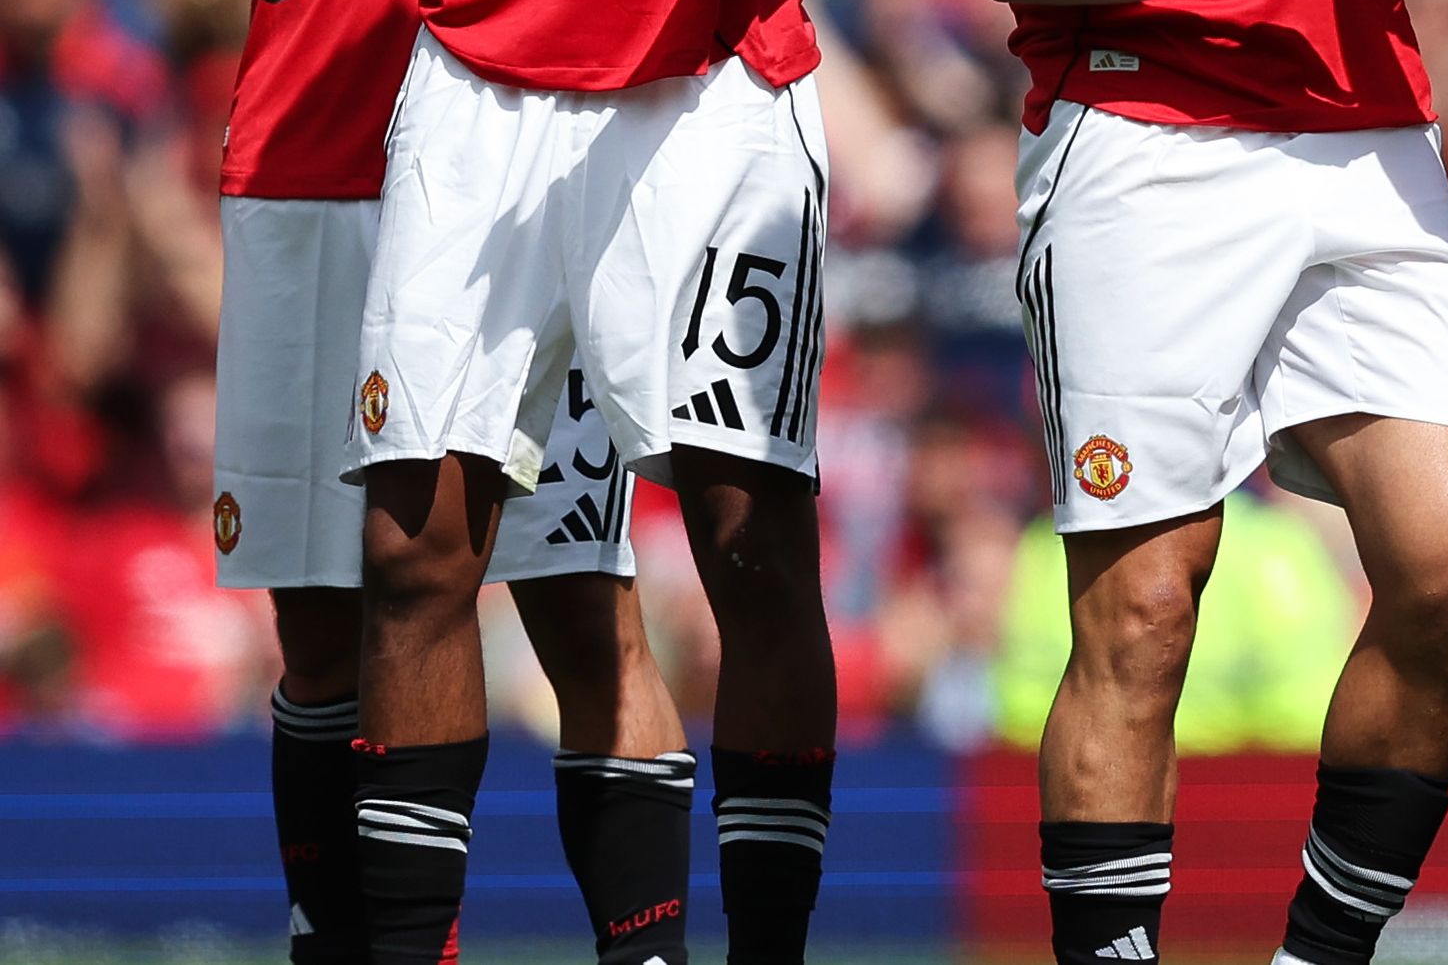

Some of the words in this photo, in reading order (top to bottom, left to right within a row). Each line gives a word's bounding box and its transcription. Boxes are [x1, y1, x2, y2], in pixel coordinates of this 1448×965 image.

[680, 245, 788, 370] 15
[538, 368, 618, 482] 5
[1077, 439, 1124, 463] MANCHESTER
[1089, 482, 1122, 497] UNITED
[608, 898, 681, 937] MUFC
